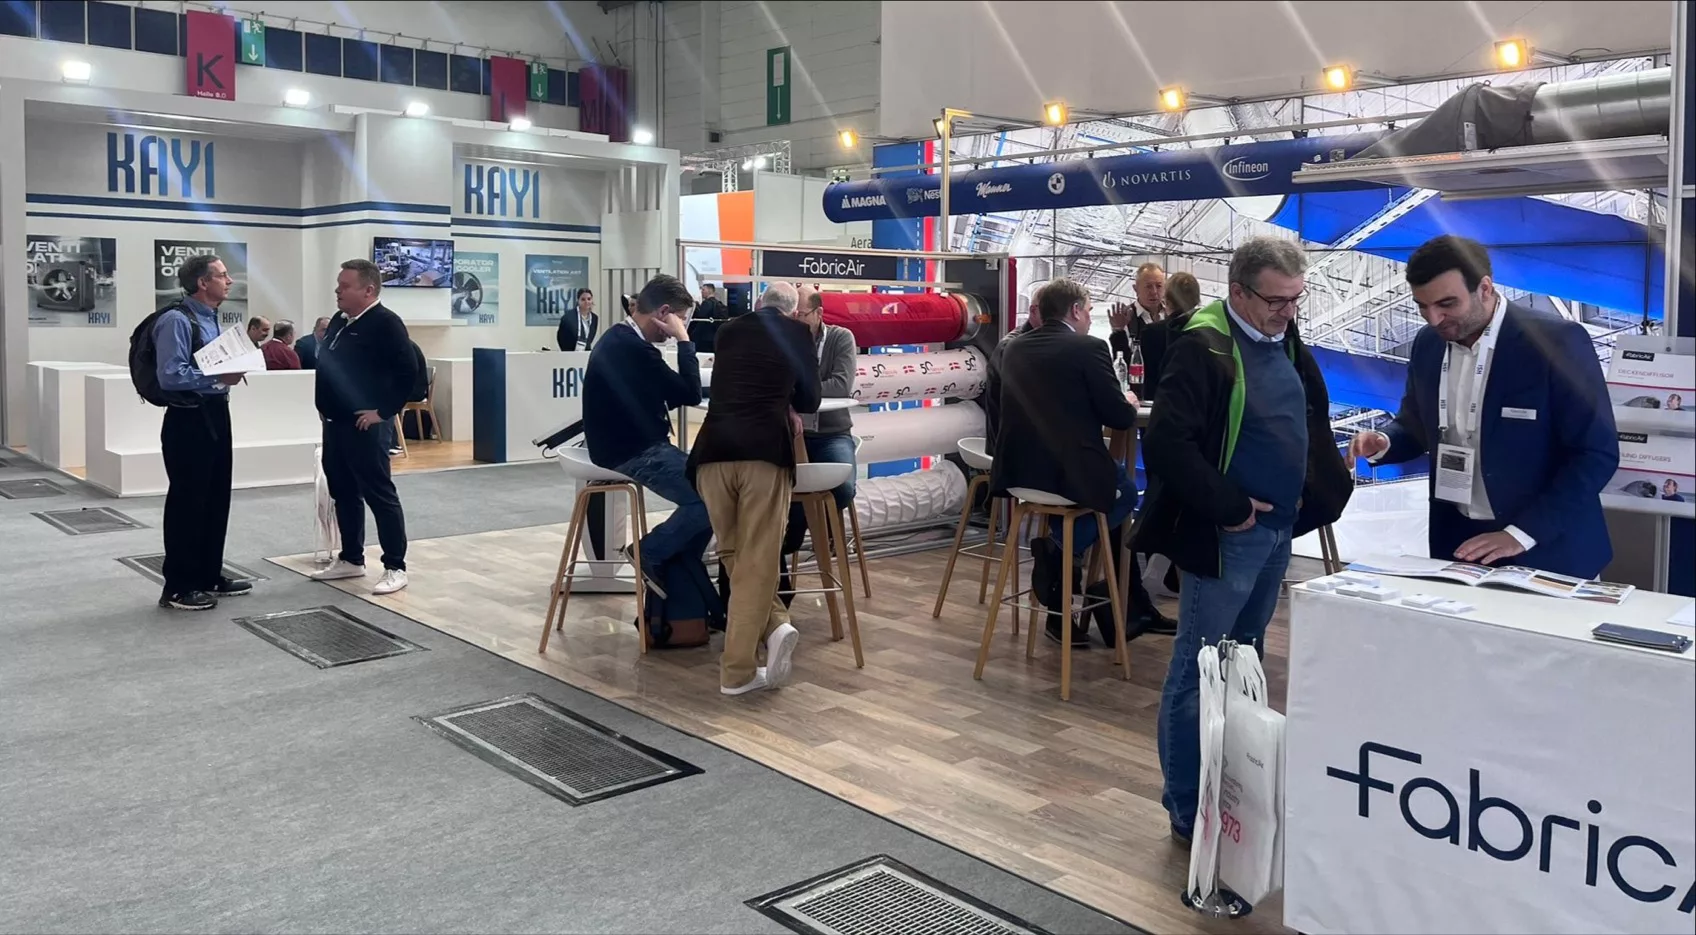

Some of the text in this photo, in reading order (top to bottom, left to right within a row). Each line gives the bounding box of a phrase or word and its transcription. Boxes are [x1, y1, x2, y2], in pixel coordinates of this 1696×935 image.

[196, 52, 224, 89] K
[107, 132, 215, 198] KAYI
[1228, 162, 1269, 174] Infineon
[1121, 169, 1192, 187] NOVARTIS
[464, 164, 540, 218] KAYI
[851, 195, 886, 208] MAGNA
[161, 245, 215, 256] VENTI
[799, 257, 865, 276] FabricAir
[88, 312, 110, 324] KAYI
[222, 312, 242, 323] KAYI
[478, 313, 495, 324] KAYI
